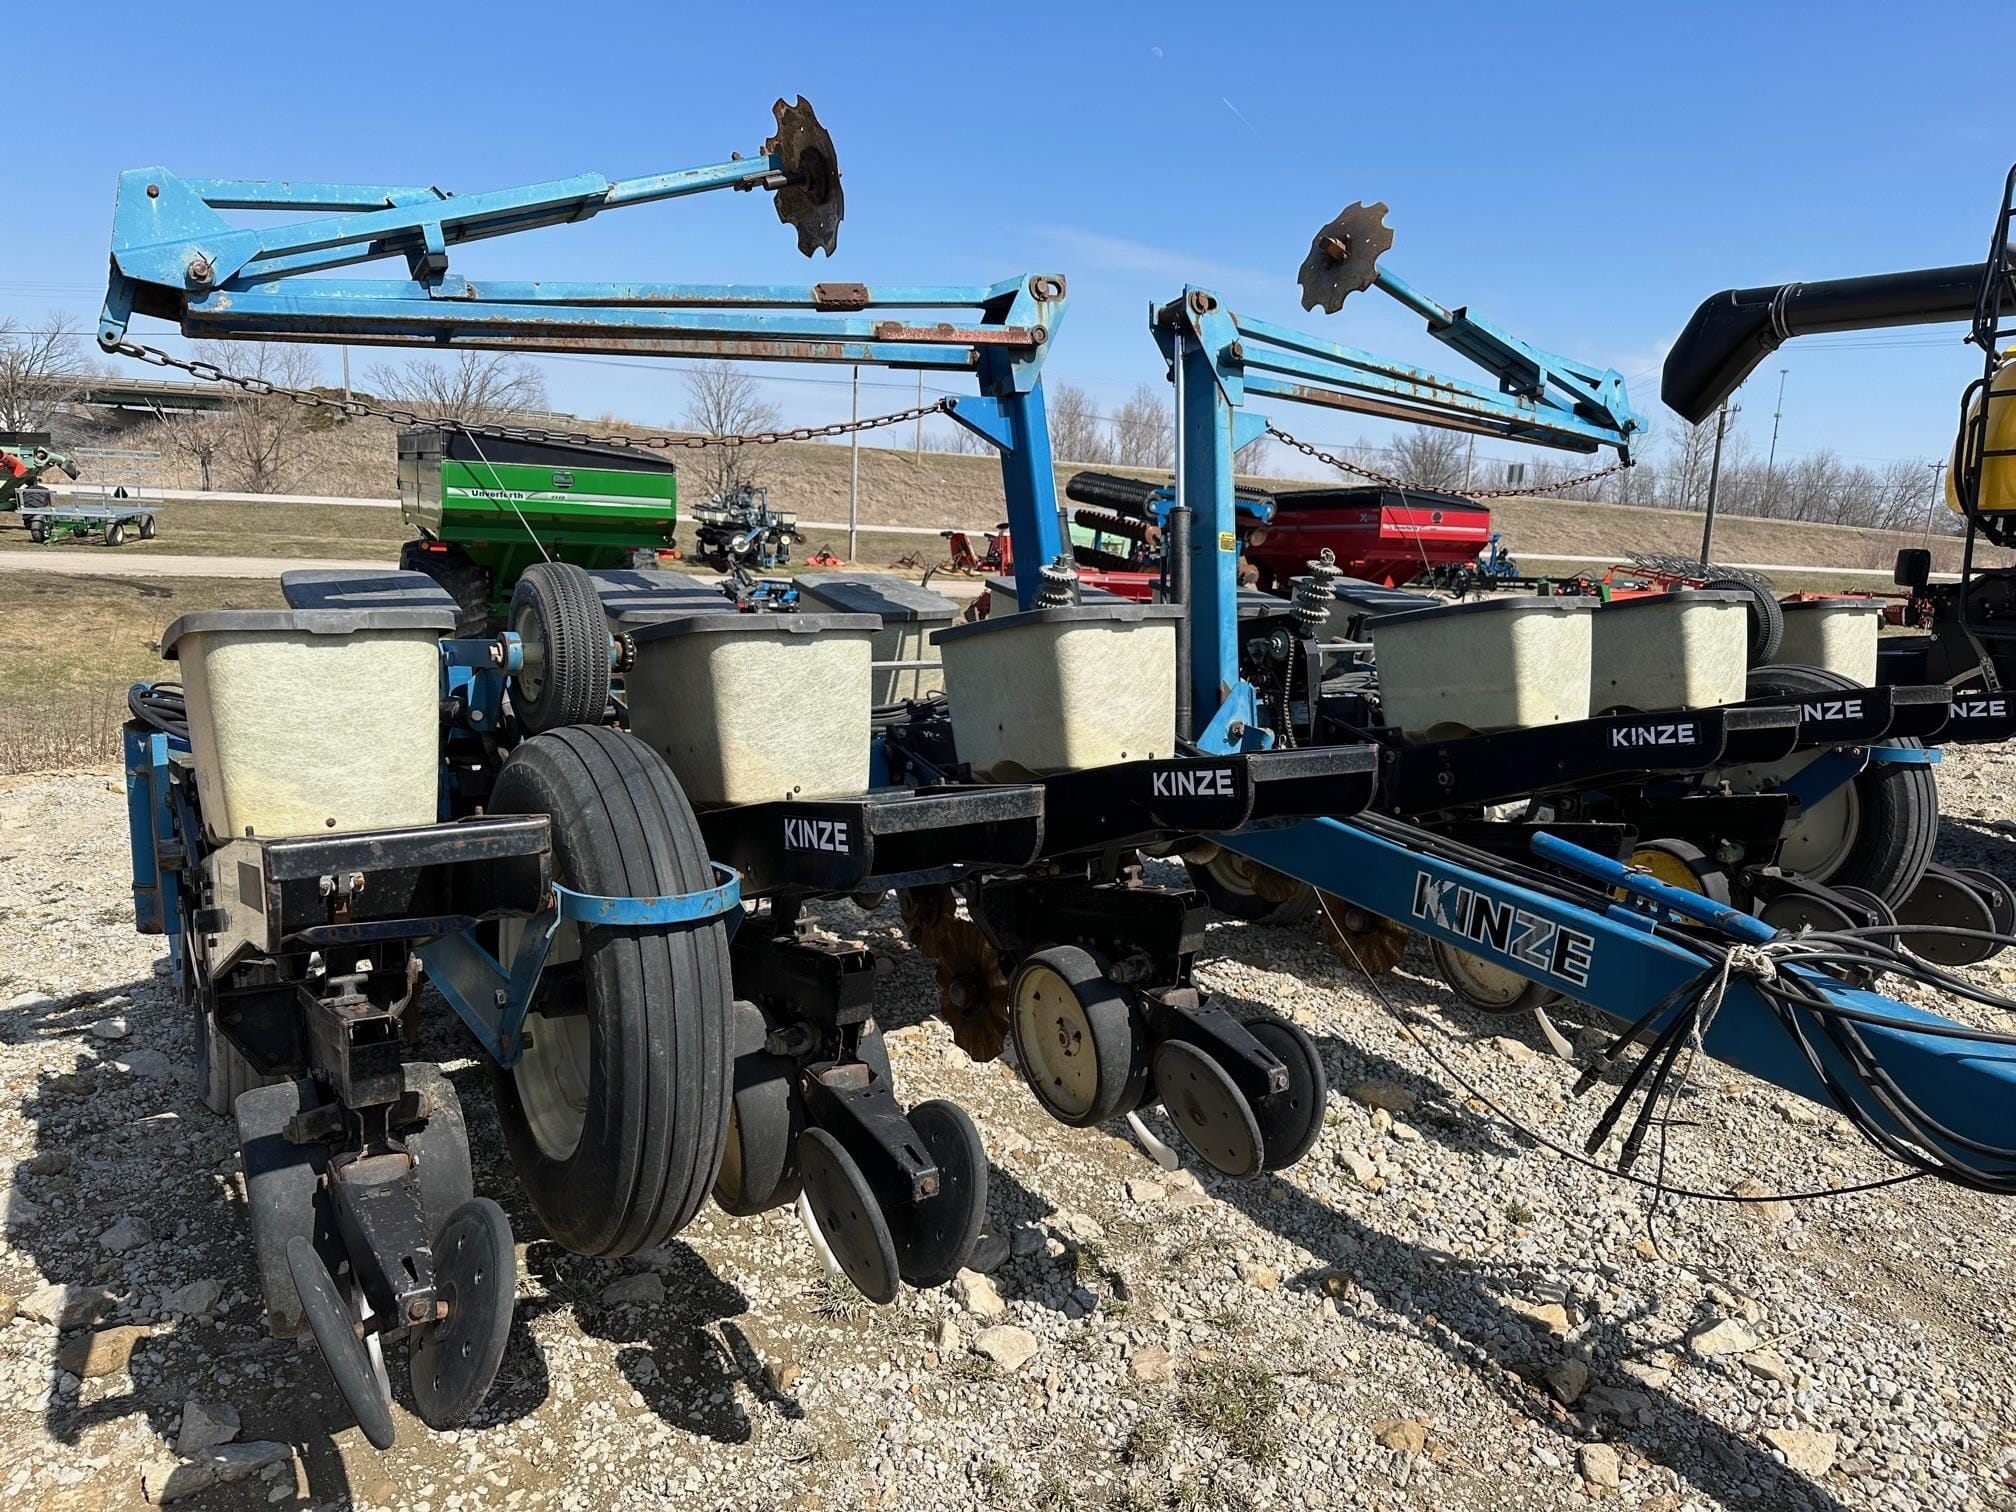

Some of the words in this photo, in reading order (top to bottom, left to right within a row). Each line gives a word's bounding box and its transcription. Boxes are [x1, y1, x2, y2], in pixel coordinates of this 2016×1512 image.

[1803, 699, 1863, 722] NZE
[1950, 700, 2006, 719] NZE
[1612, 723, 1695, 747] KINZE
[1152, 769, 1234, 796] KINZE
[784, 818, 849, 853] KINZE
[1412, 870, 1595, 988] KINZE
